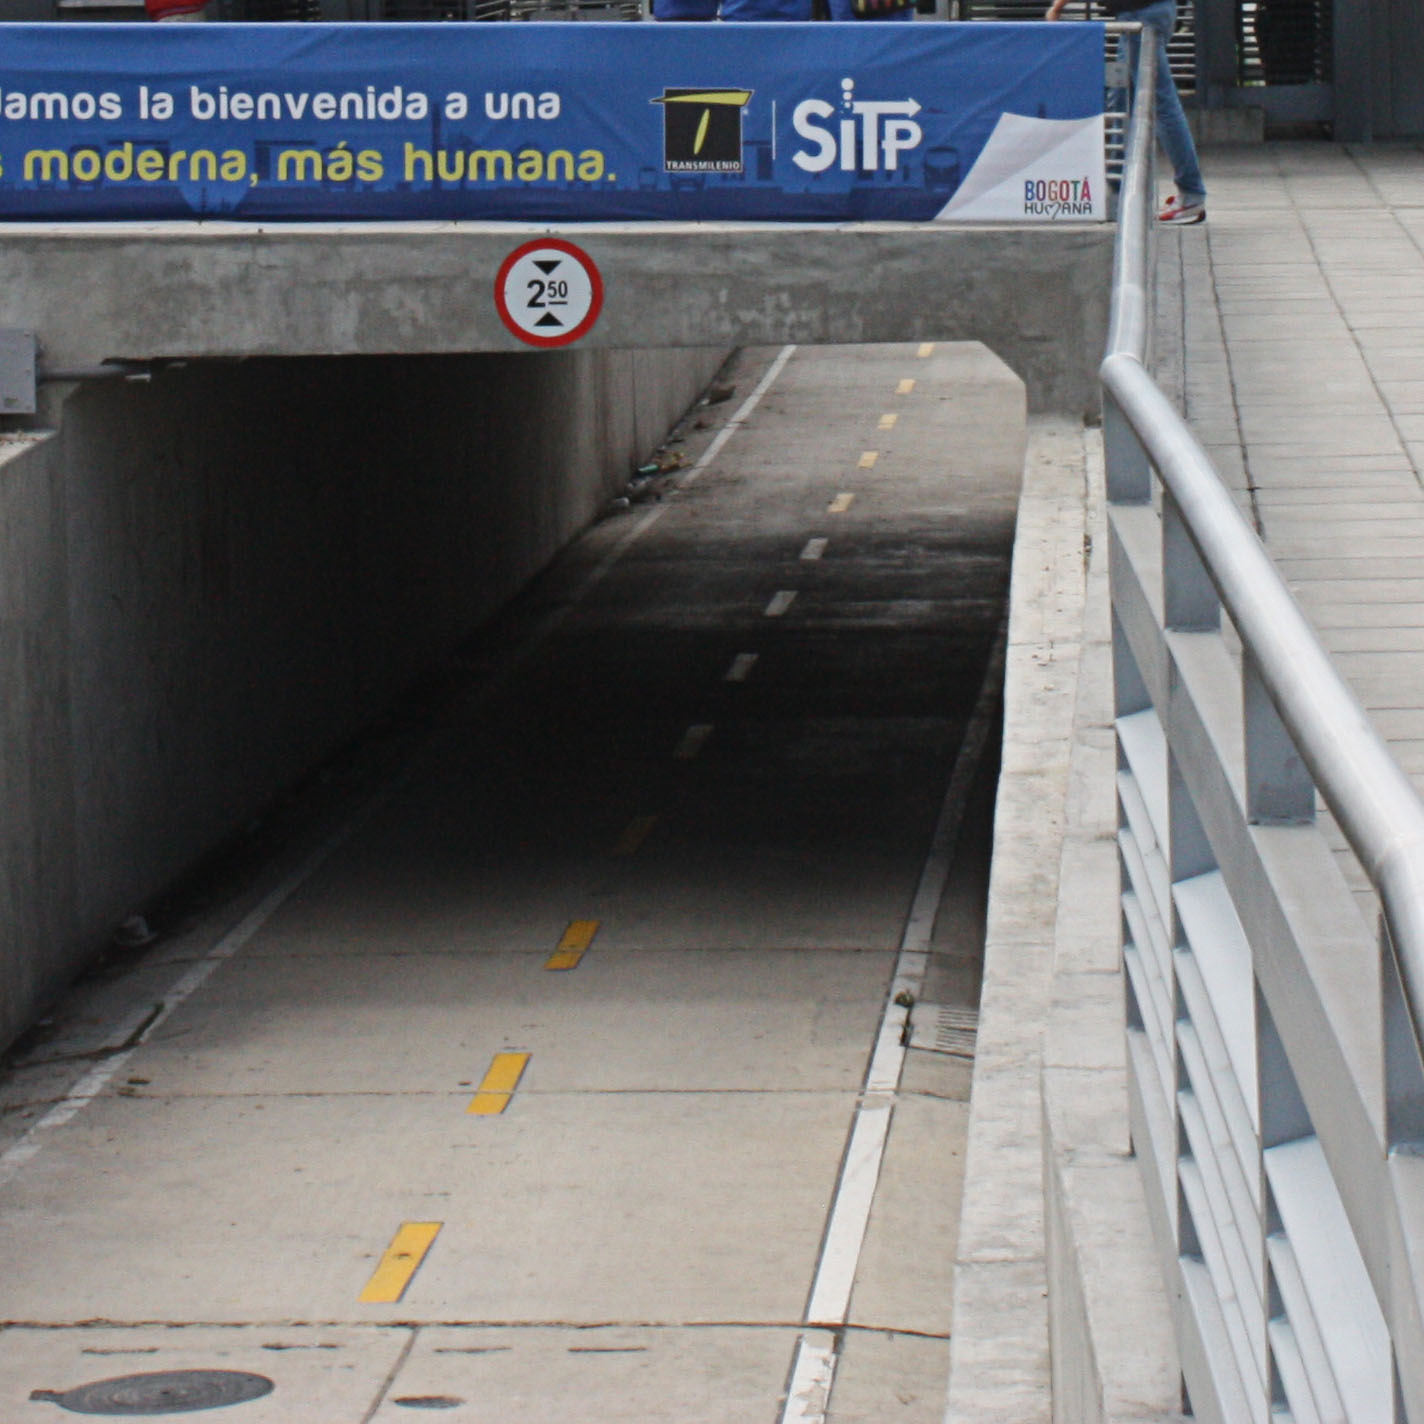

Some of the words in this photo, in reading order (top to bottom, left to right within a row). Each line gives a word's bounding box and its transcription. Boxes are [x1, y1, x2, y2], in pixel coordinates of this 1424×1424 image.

[139, 85, 174, 120] la
[190, 85, 428, 120] bienvenida
[444, 92, 468, 120] a
[485, 92, 561, 120] una
[23, 142, 258, 187] moderna,
[277, 142, 383, 182] más
[404, 142, 616, 182] humana.
[666, 160, 740, 171] TRANSMILENIO
[1024, 177, 1092, 202] BOGOTÁ
